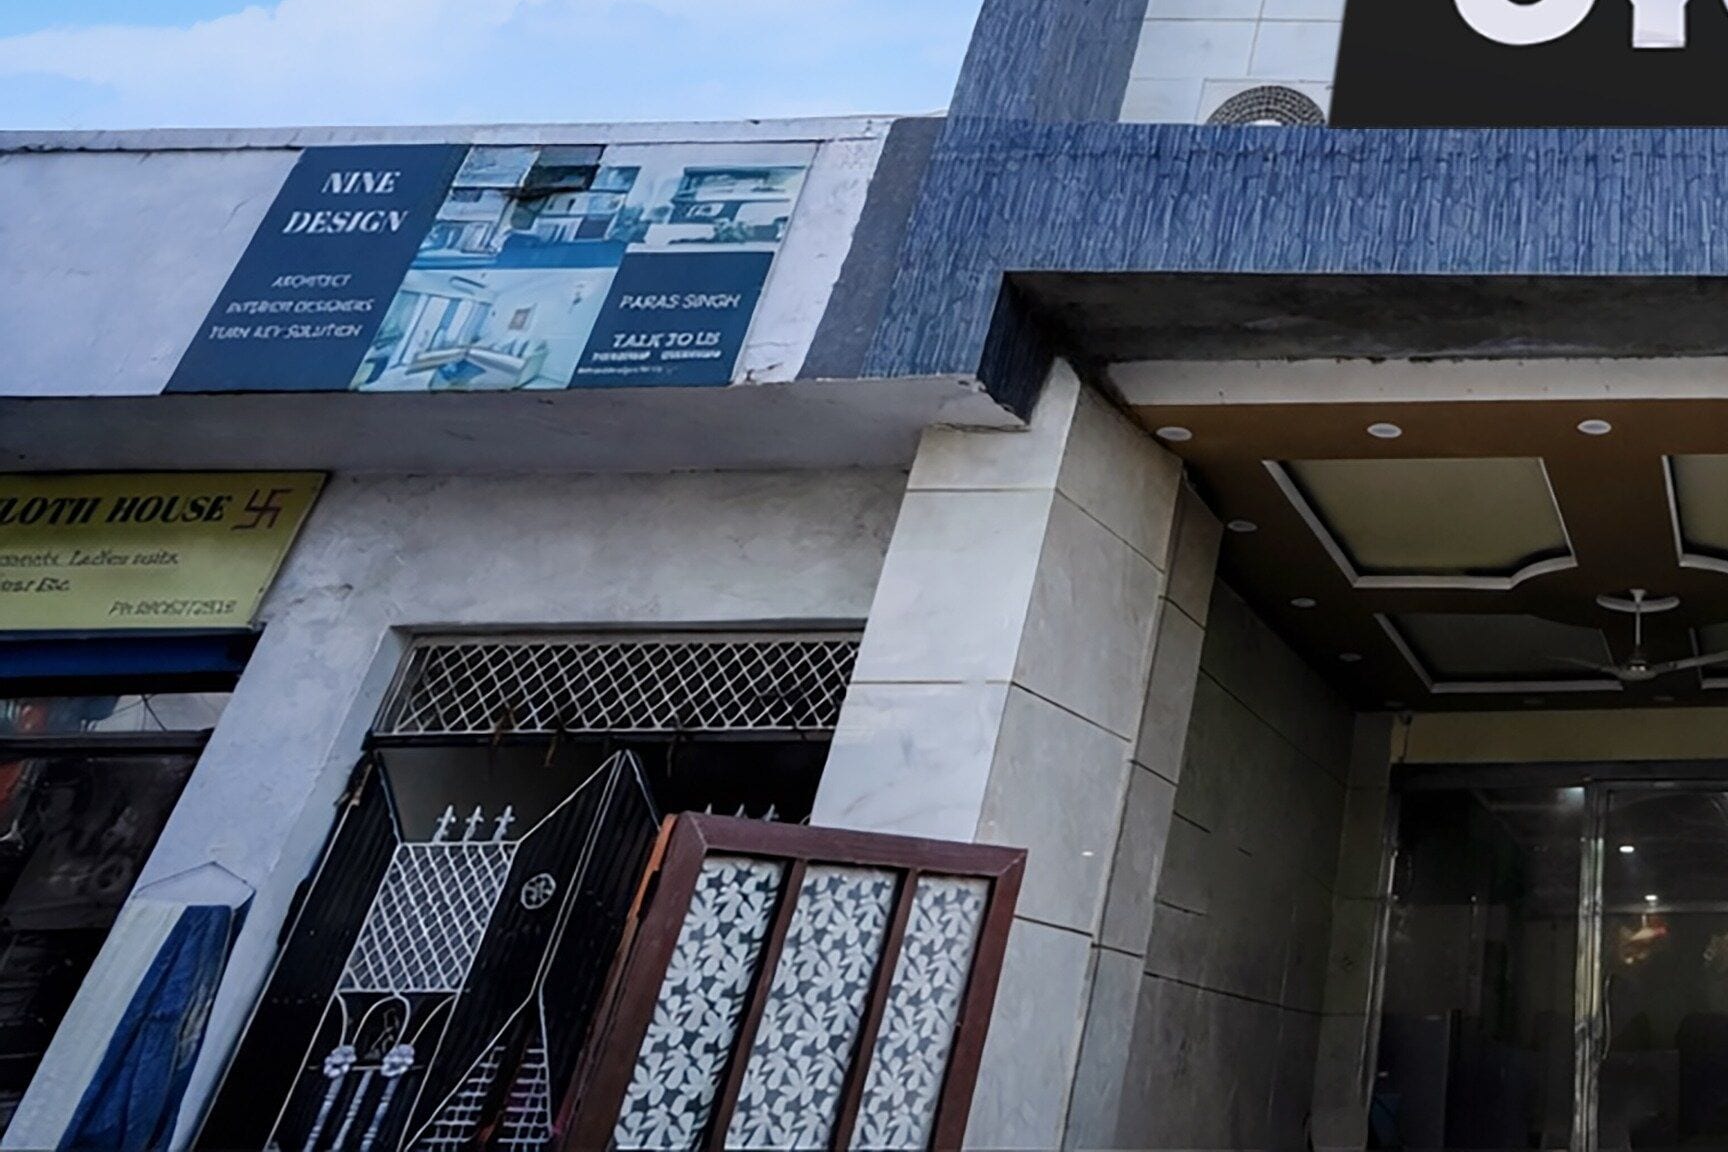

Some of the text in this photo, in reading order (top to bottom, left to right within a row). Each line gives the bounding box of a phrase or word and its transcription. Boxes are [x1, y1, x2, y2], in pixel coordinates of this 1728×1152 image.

[321, 171, 401, 194] NINE
[282, 210, 409, 234] DESIGN
[619, 294, 741, 309] PARAS SINGH
[209, 323, 364, 340] TURN KEY SOLUTION
[613, 331, 721, 348] TALK TO US
[0, 495, 233, 526] LOTH HOUSE
